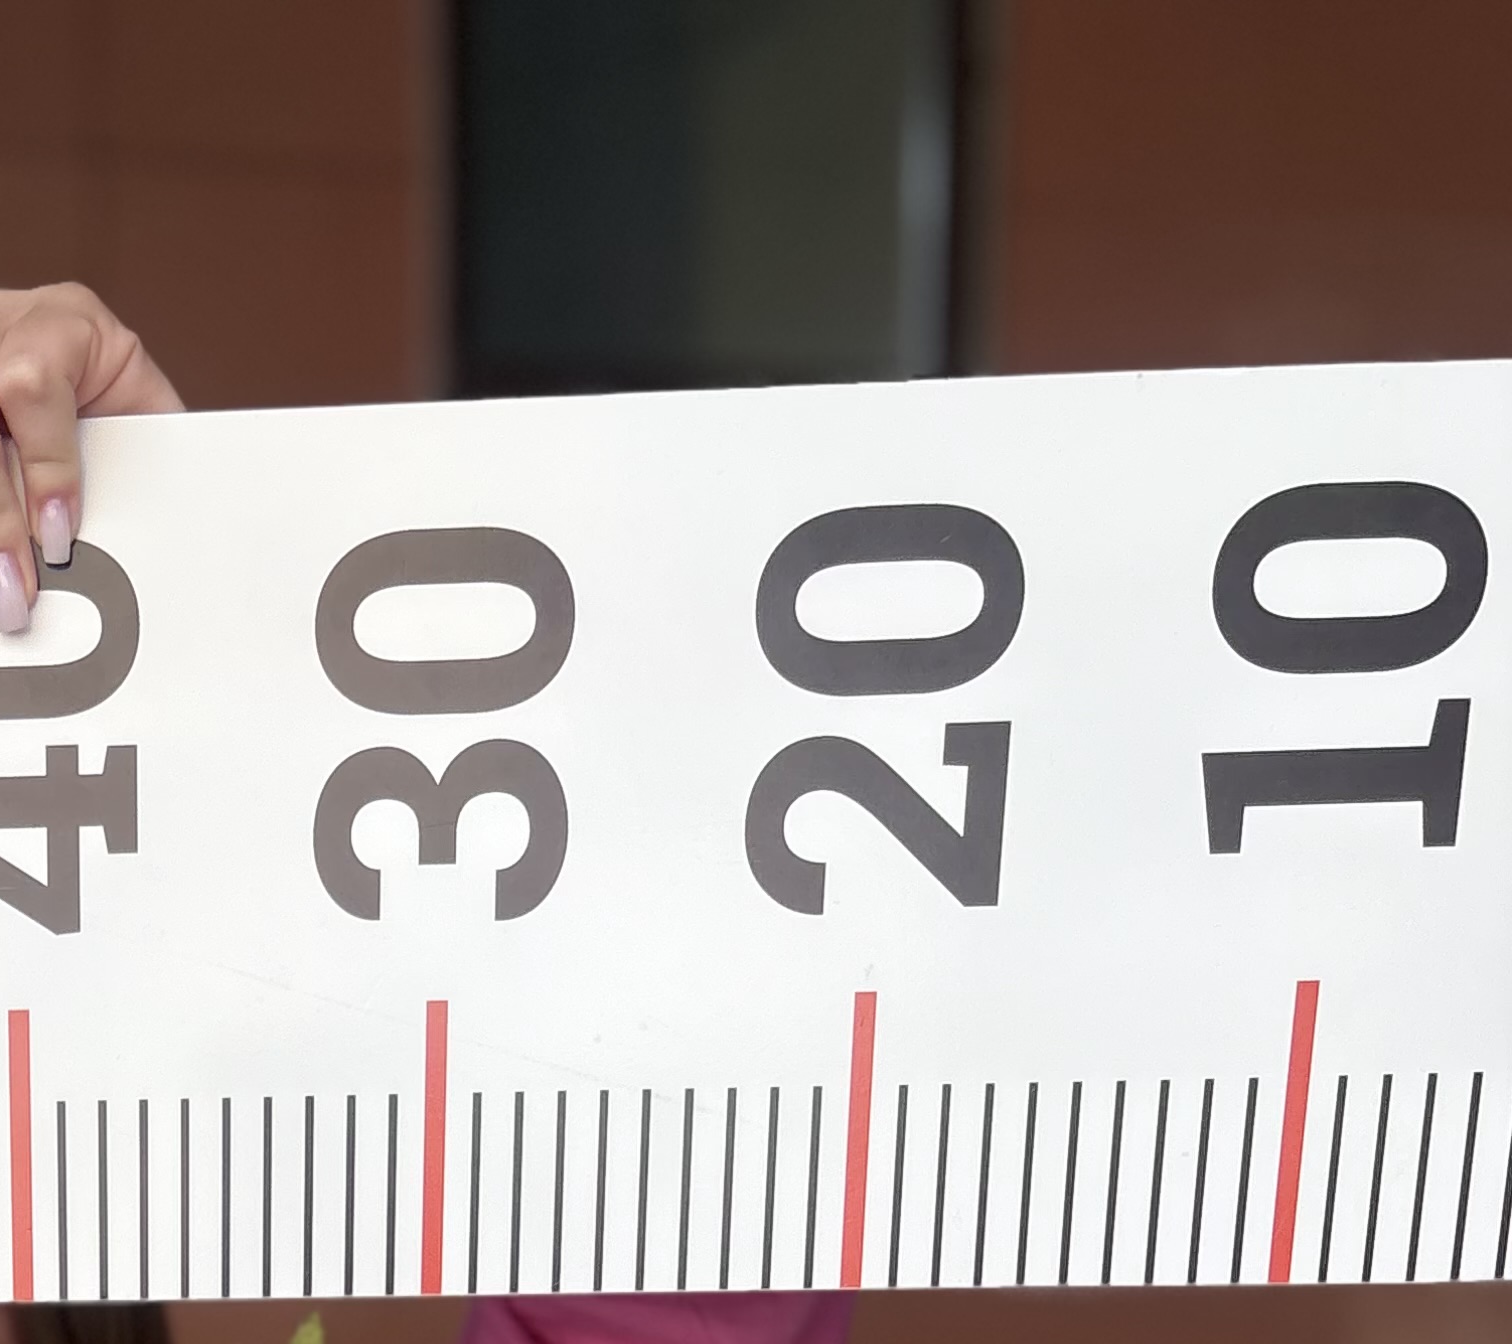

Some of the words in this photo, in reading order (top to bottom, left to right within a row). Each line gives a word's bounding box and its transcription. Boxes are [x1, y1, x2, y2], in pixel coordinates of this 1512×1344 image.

[314, 526, 569, 920] 30
[745, 504, 1025, 914] 20
[1202, 481, 1488, 854] 10
